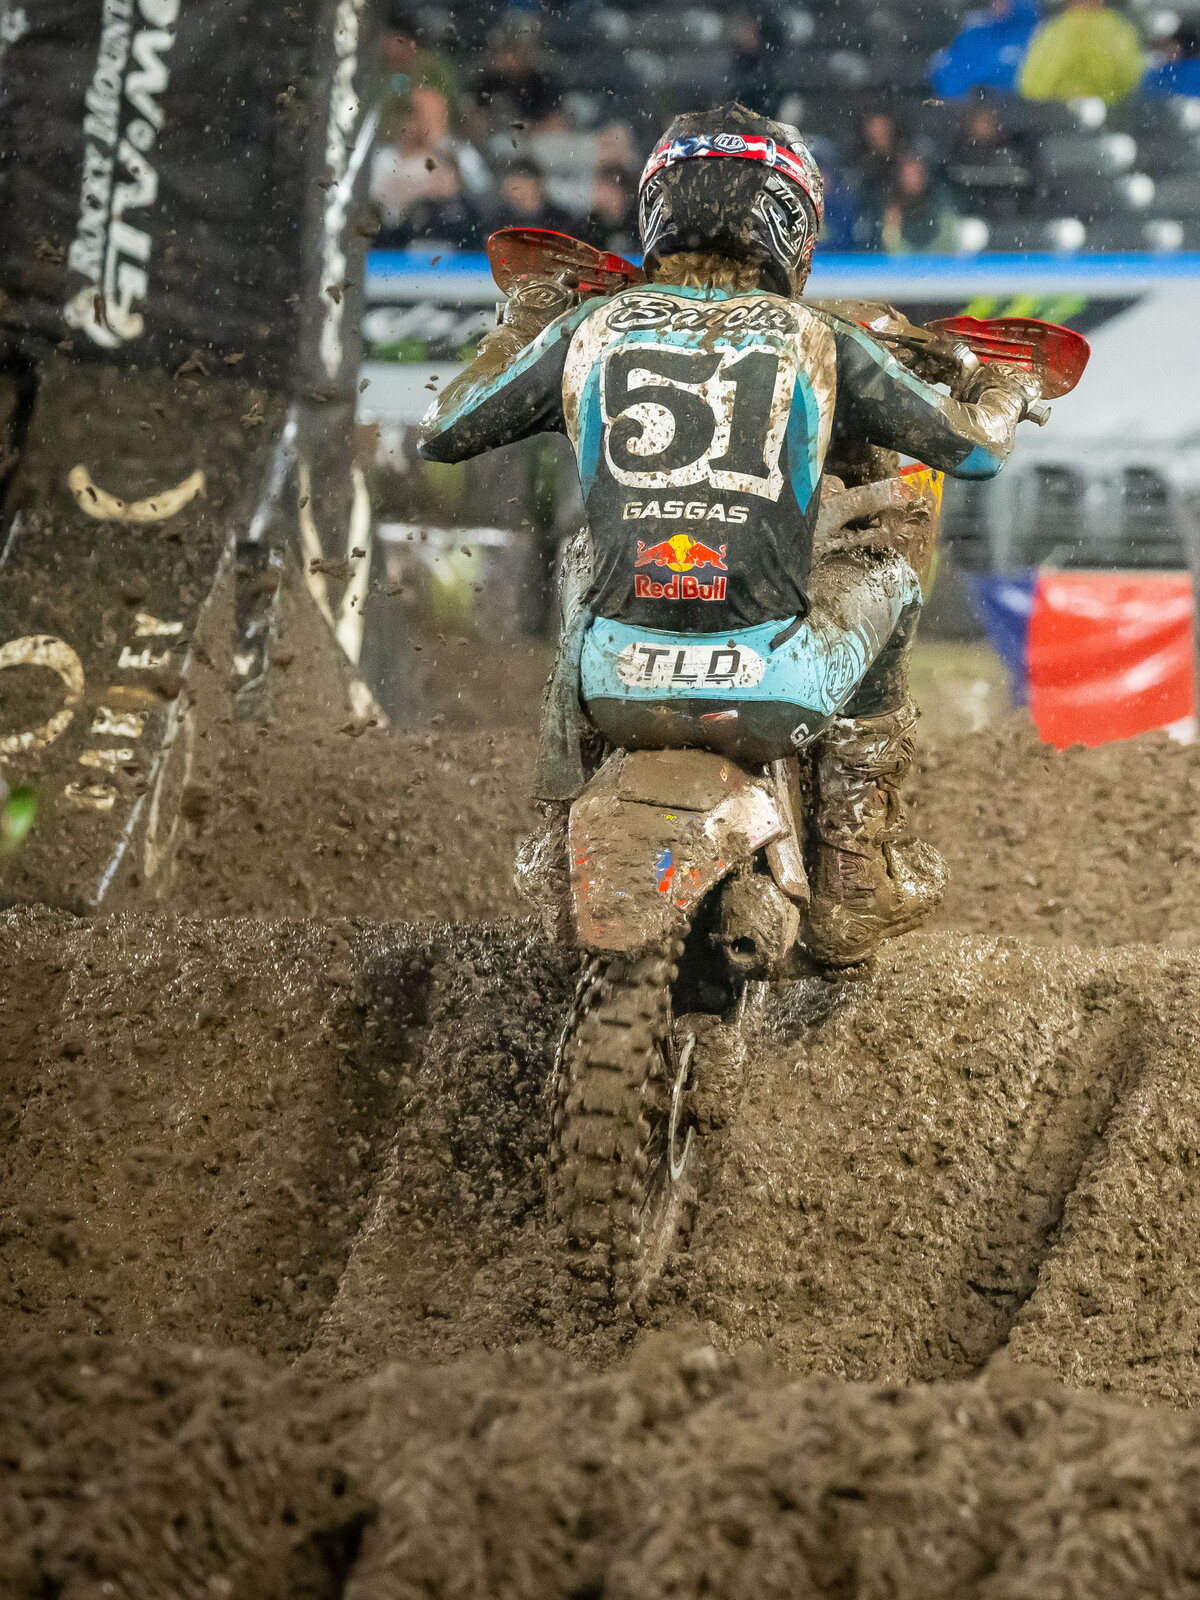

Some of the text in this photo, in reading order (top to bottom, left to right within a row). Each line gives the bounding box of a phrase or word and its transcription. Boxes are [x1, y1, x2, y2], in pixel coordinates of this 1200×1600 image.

[603, 345, 783, 502] 51
[622, 502, 749, 524] GASGAS
[634, 574, 727, 601] Red Bull
[638, 647, 741, 683] TLD
